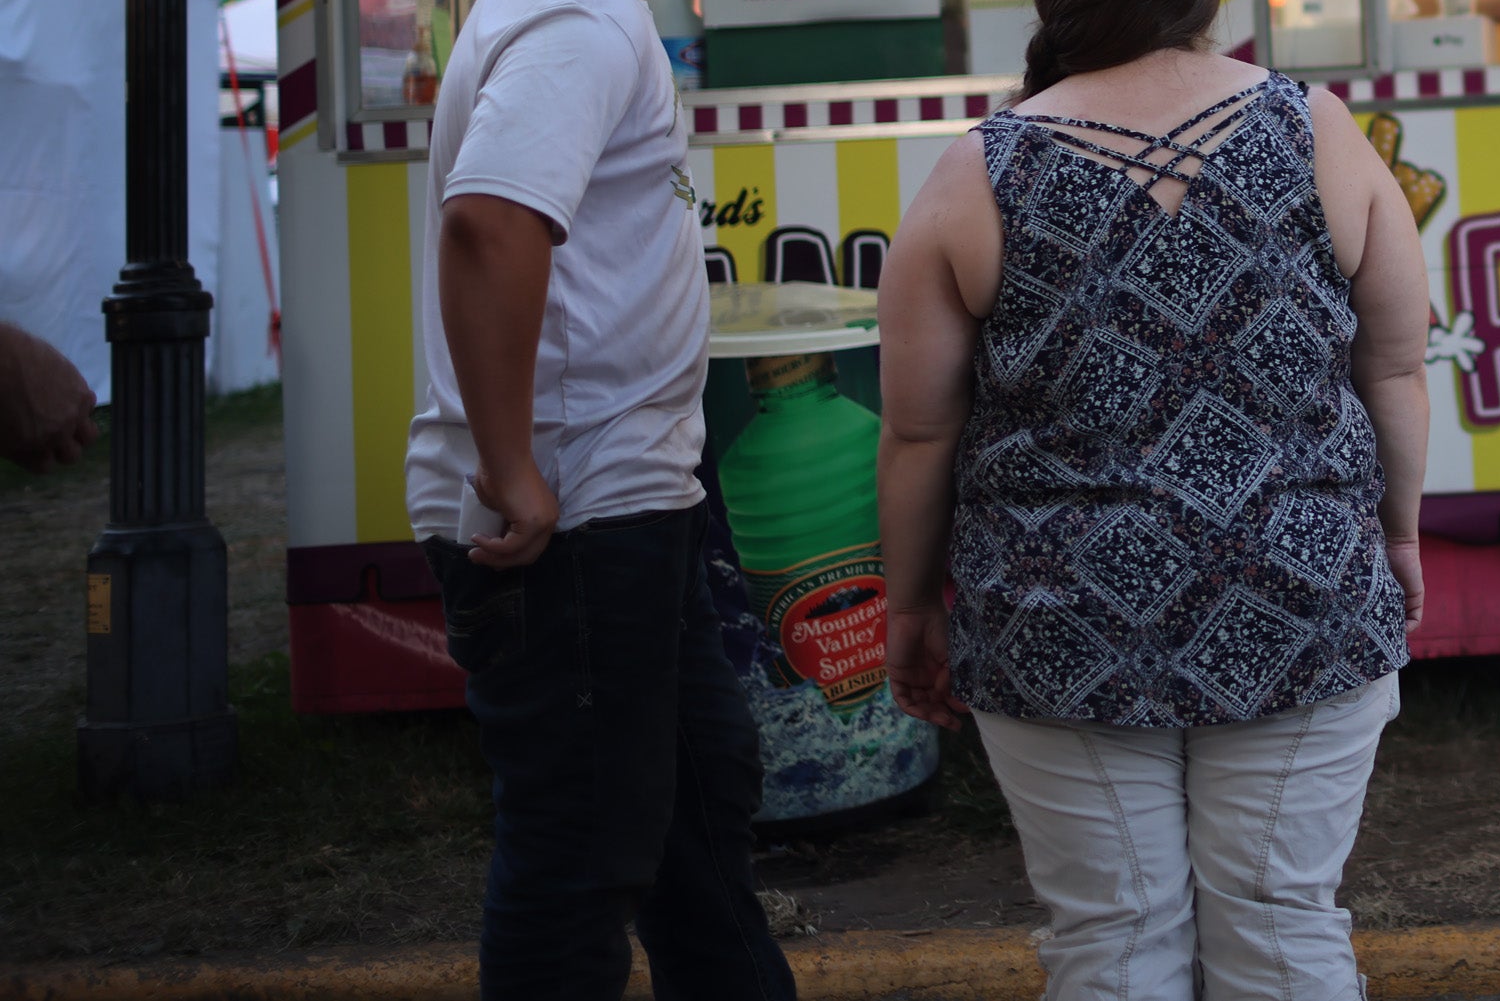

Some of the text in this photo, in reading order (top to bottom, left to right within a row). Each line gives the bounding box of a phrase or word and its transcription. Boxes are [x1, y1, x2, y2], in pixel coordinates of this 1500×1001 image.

[791, 596, 888, 643] Mountain
[816, 618, 882, 655] Valley
[819, 641, 885, 681] Spring
